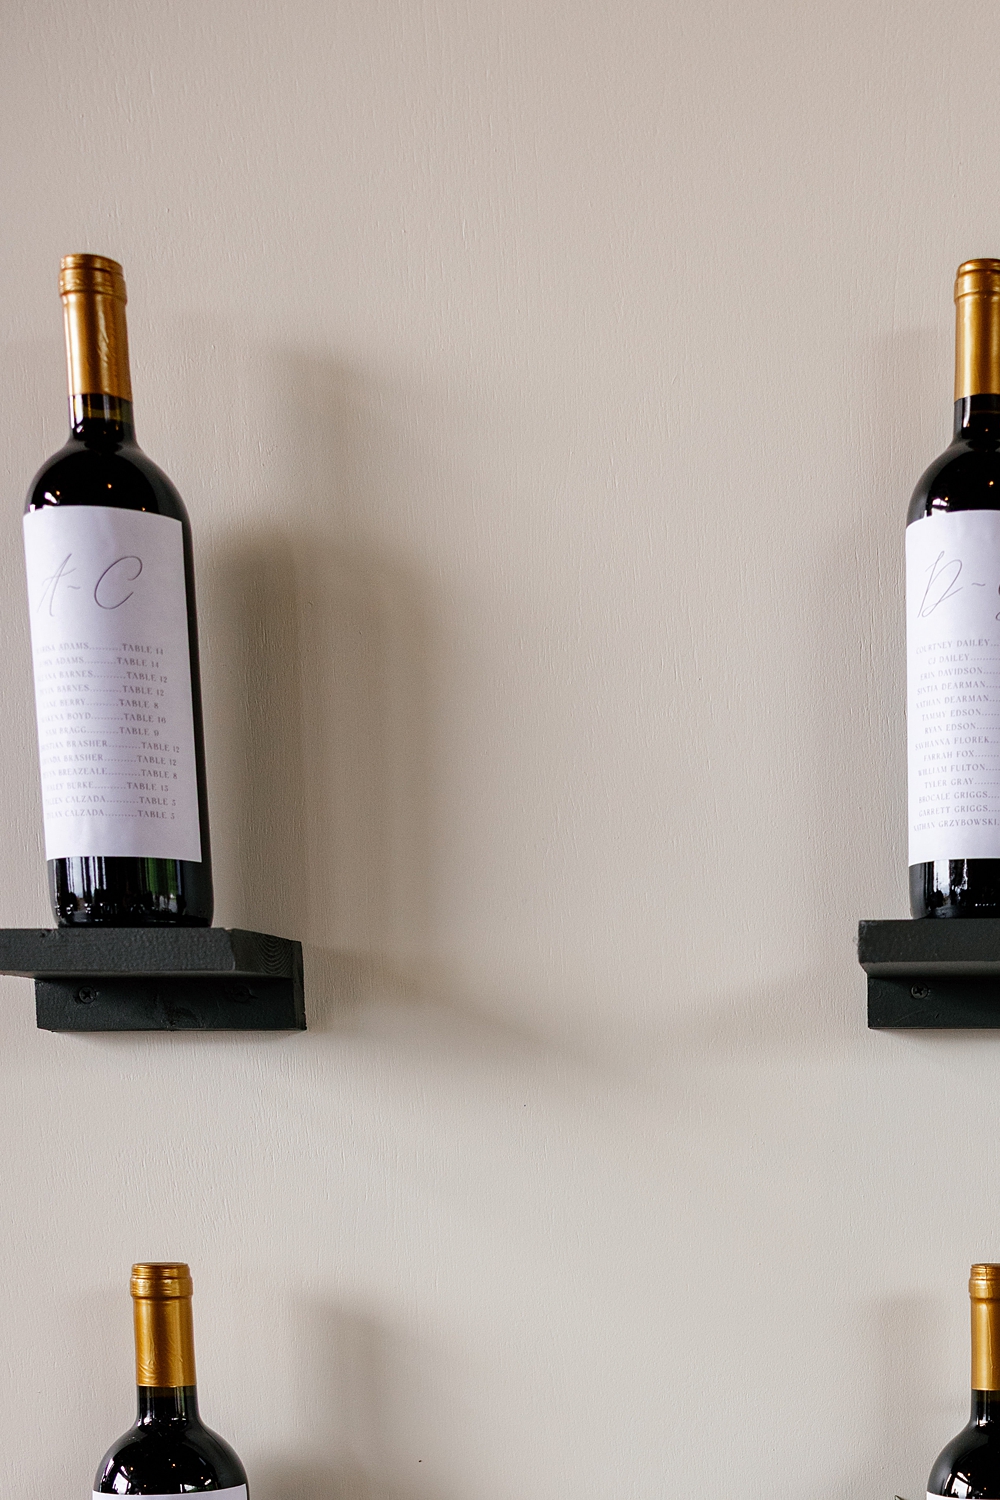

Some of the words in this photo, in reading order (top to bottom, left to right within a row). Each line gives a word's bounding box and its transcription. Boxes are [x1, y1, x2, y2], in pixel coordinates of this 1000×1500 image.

[37, 553, 76, 617] A
[94, 555, 143, 610] C
[917, 551, 963, 619] D
[59, 642, 89, 651] ADAMS
[122, 643, 152, 655] TABLE
[928, 657, 936, 665] CJ
[939, 653, 970, 663] DAILEY
[59, 670, 94, 679] BARNES
[127, 671, 157, 682] TABLE
[67, 712, 92, 720] BOYD
[123, 712, 154, 723] TABLE
[922, 710, 947, 721] TAMMY
[950, 708, 981, 717] EDSON
[66, 740, 108, 749] BRASHER
[141, 742, 170, 752] TABLE
[172, 745, 180, 753] 12
[923, 751, 953, 762] FARRAH
[956, 749, 975, 758] FOX
[925, 779, 947, 789] TYLER
[951, 777, 974, 786] GRAY
[65, 808, 105, 817] CALZADA
[138, 809, 167, 819] TABLE
